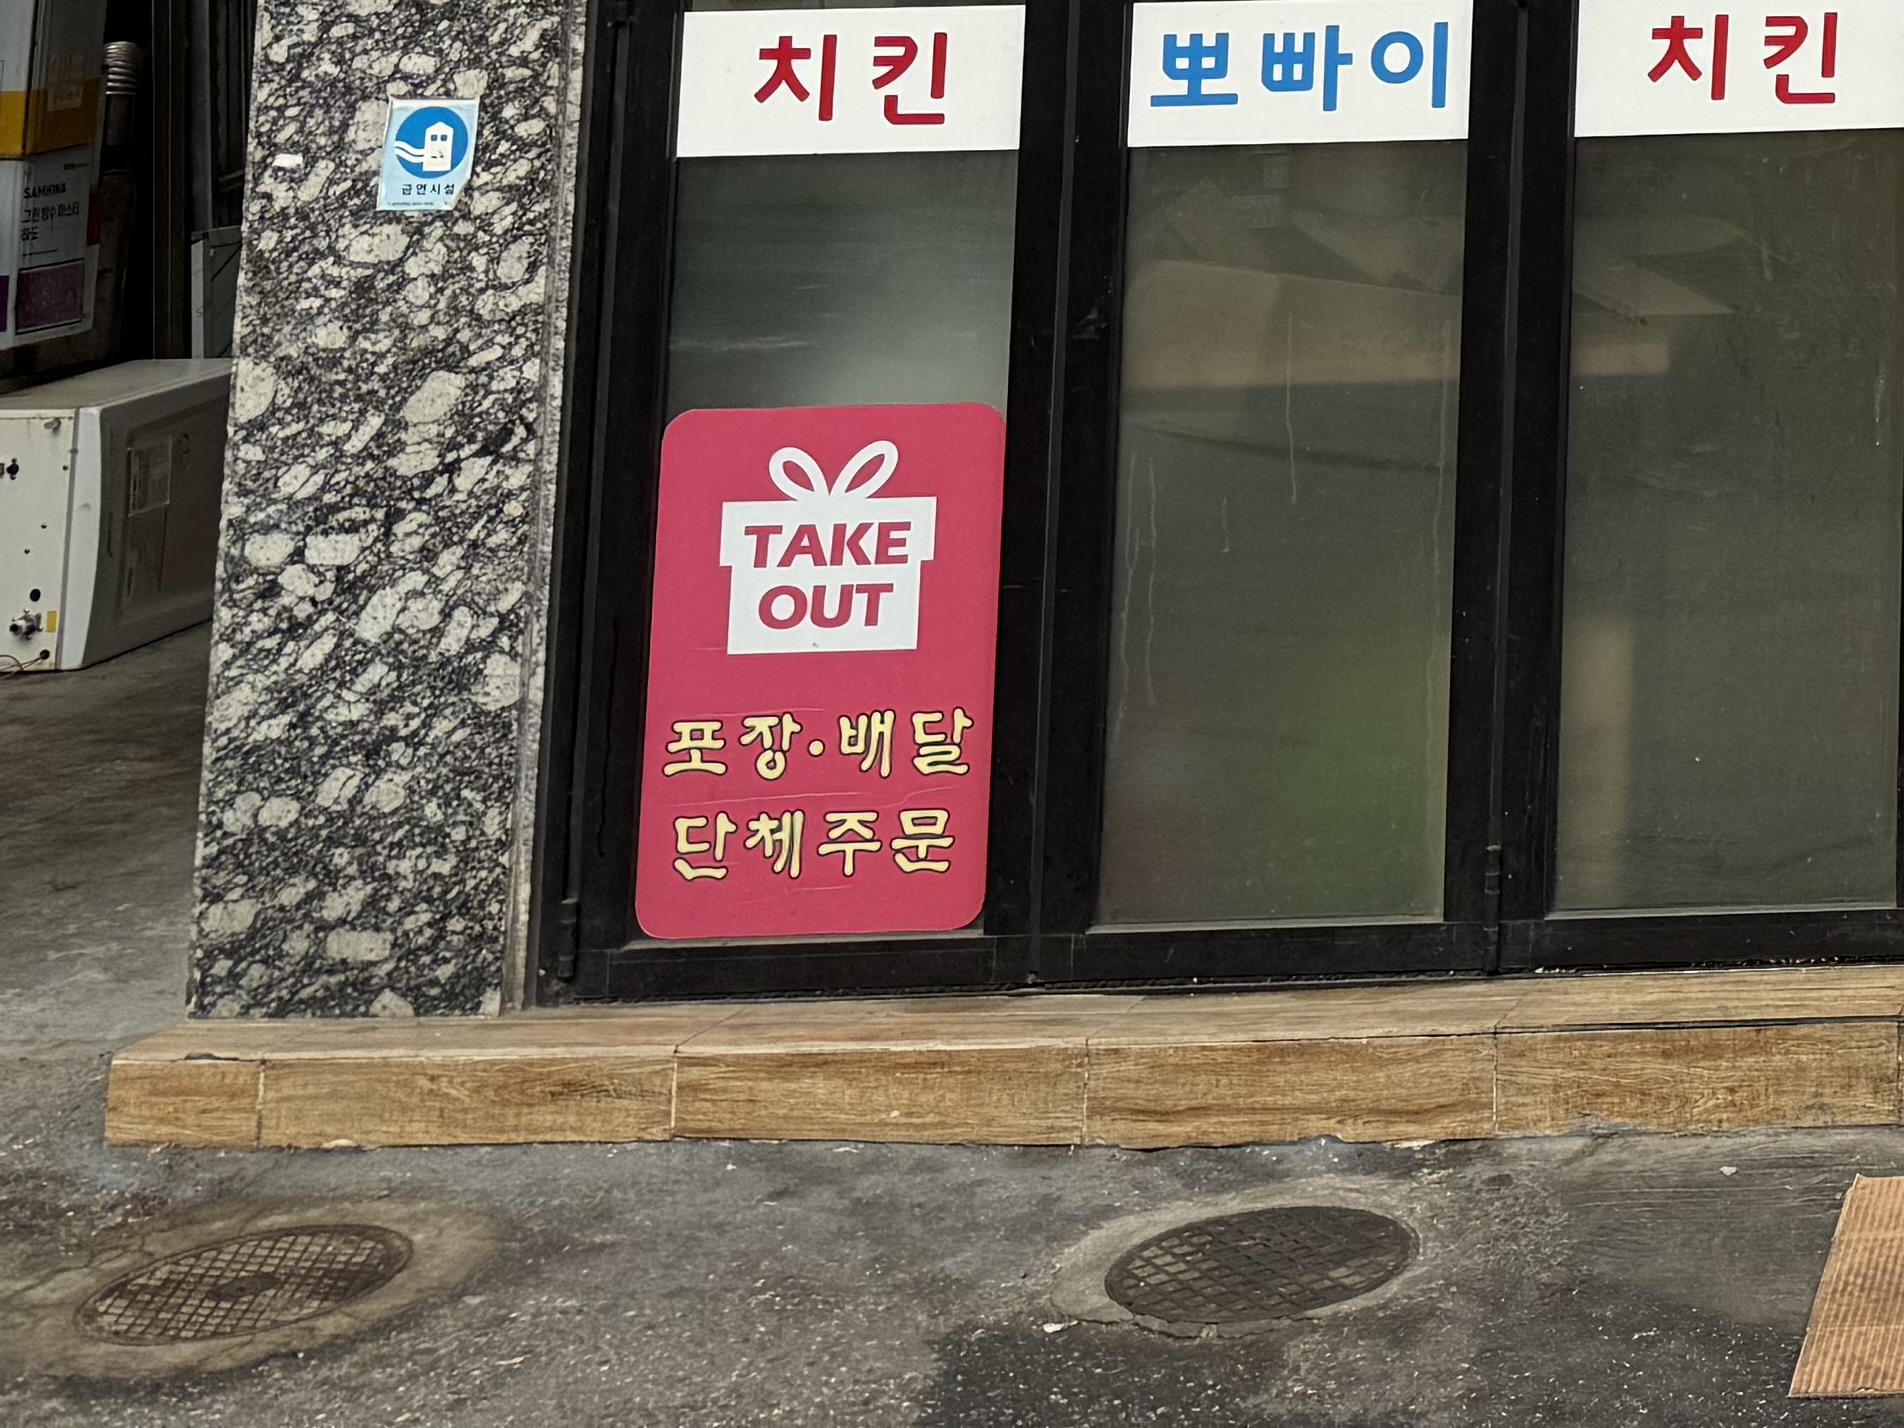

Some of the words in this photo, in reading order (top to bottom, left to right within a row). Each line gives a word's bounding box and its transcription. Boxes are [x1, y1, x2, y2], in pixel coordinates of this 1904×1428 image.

[753, 31, 949, 127] 치킨
[1150, 21, 1449, 113] 뽀빠이
[1647, 11, 1839, 105] 치킨
[401, 183, 455, 195] 금연시설
[744, 521, 911, 569] TAKE
[758, 583, 894, 629] OUT
[672, 809, 956, 880] 단체주문
